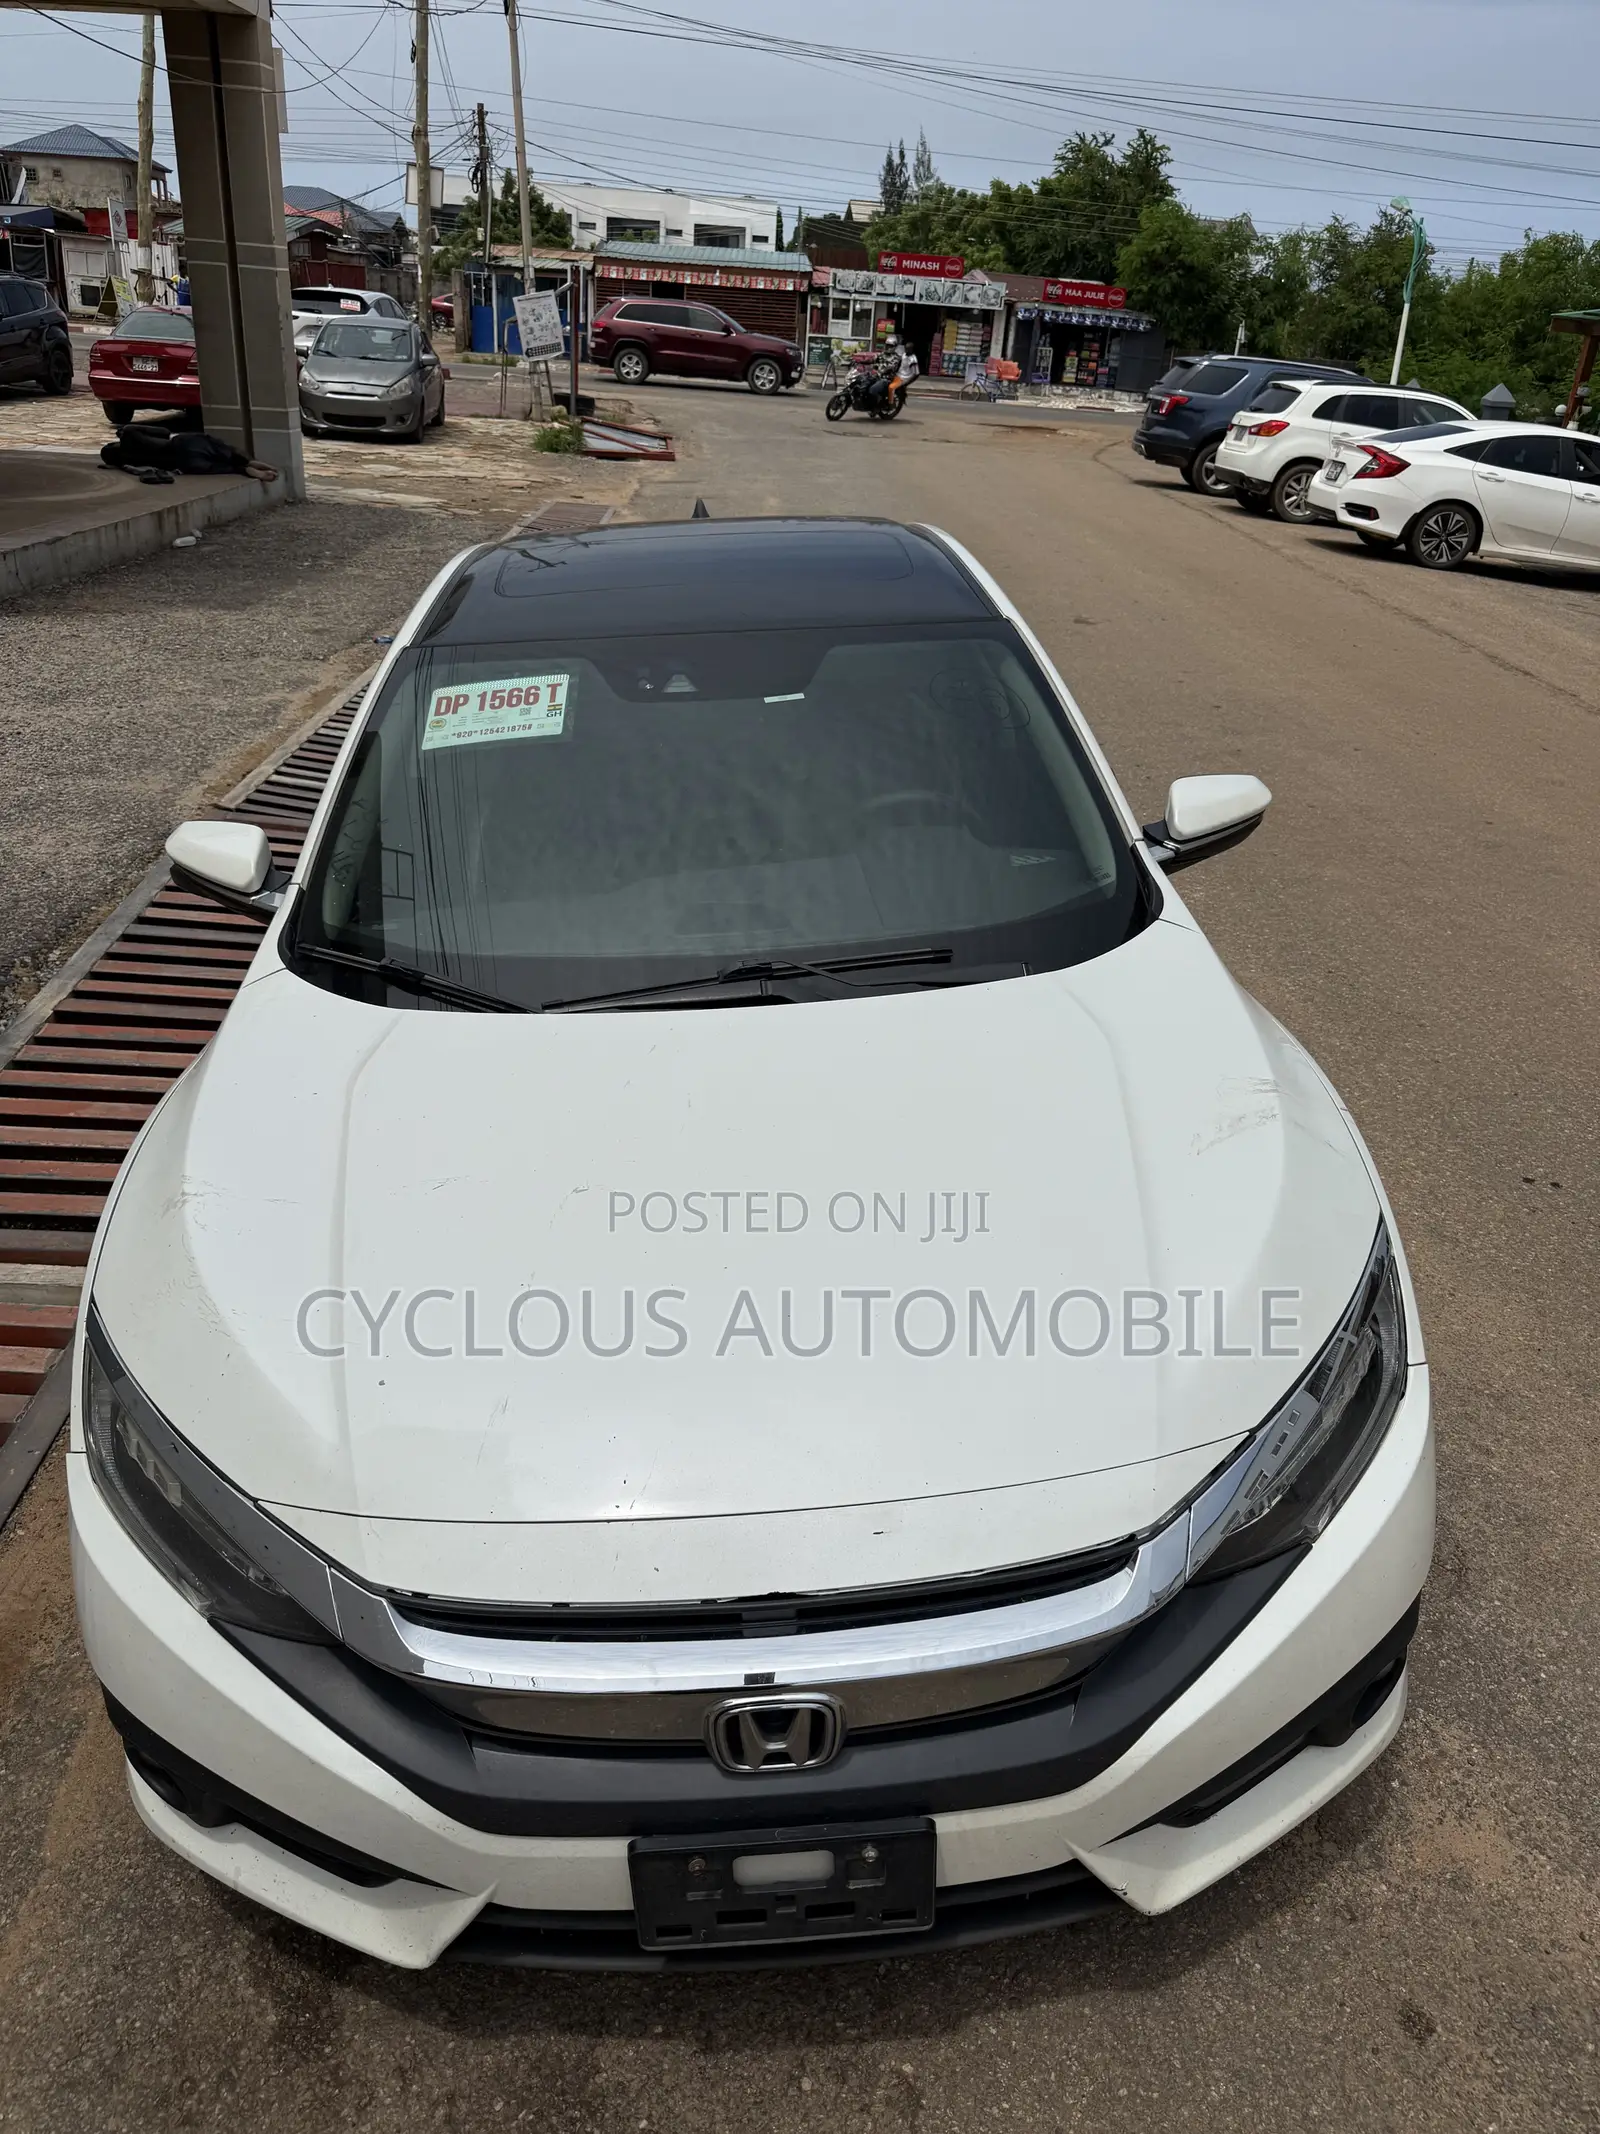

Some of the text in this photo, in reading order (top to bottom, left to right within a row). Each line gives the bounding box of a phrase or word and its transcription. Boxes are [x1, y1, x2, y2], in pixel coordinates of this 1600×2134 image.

[902, 259, 940, 271] MINASH
[1065, 288, 1082, 298] MAA
[1083, 290, 1105, 300] JULIE
[435, 683, 563, 716] DP 1566 T
